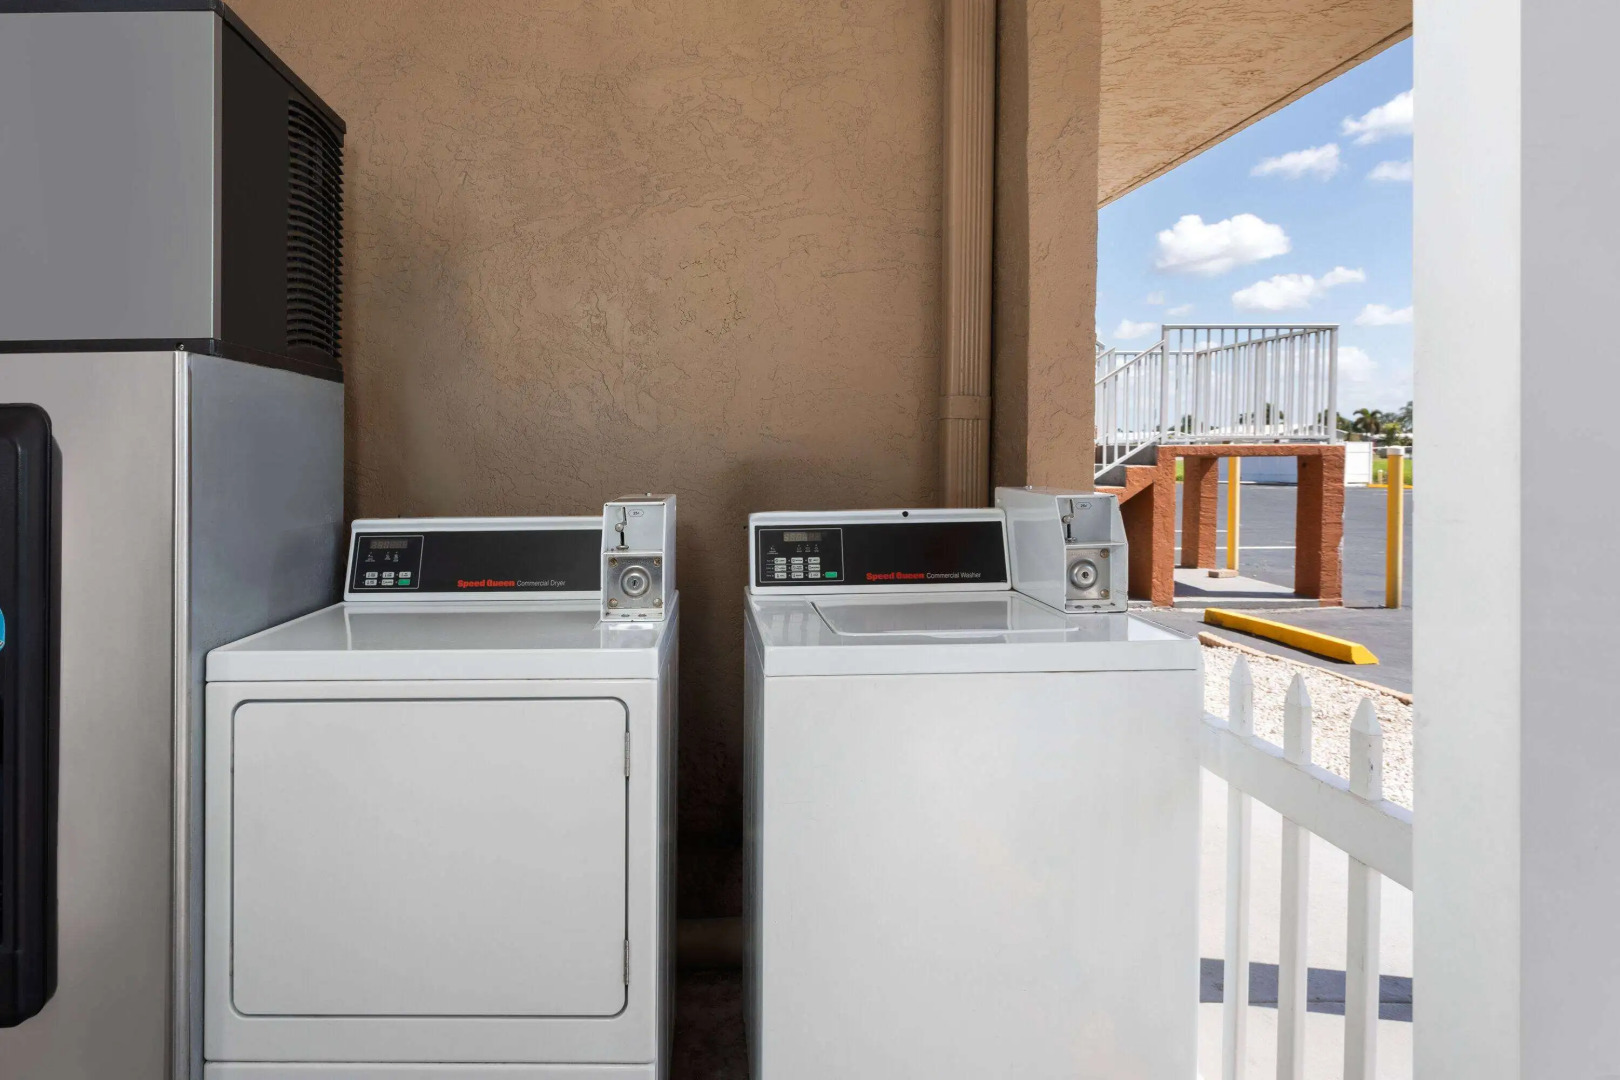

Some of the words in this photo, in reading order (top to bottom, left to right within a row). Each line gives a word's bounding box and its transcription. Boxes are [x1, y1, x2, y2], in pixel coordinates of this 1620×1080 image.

[866, 572, 895, 581] Speed
[896, 571, 925, 580] Queen
[926, 571, 960, 579] Commercial
[457, 579, 486, 588] Speed
[486, 579, 516, 588] Queen
[516, 579, 550, 587] Commercial
[550, 579, 566, 588] Dryer
